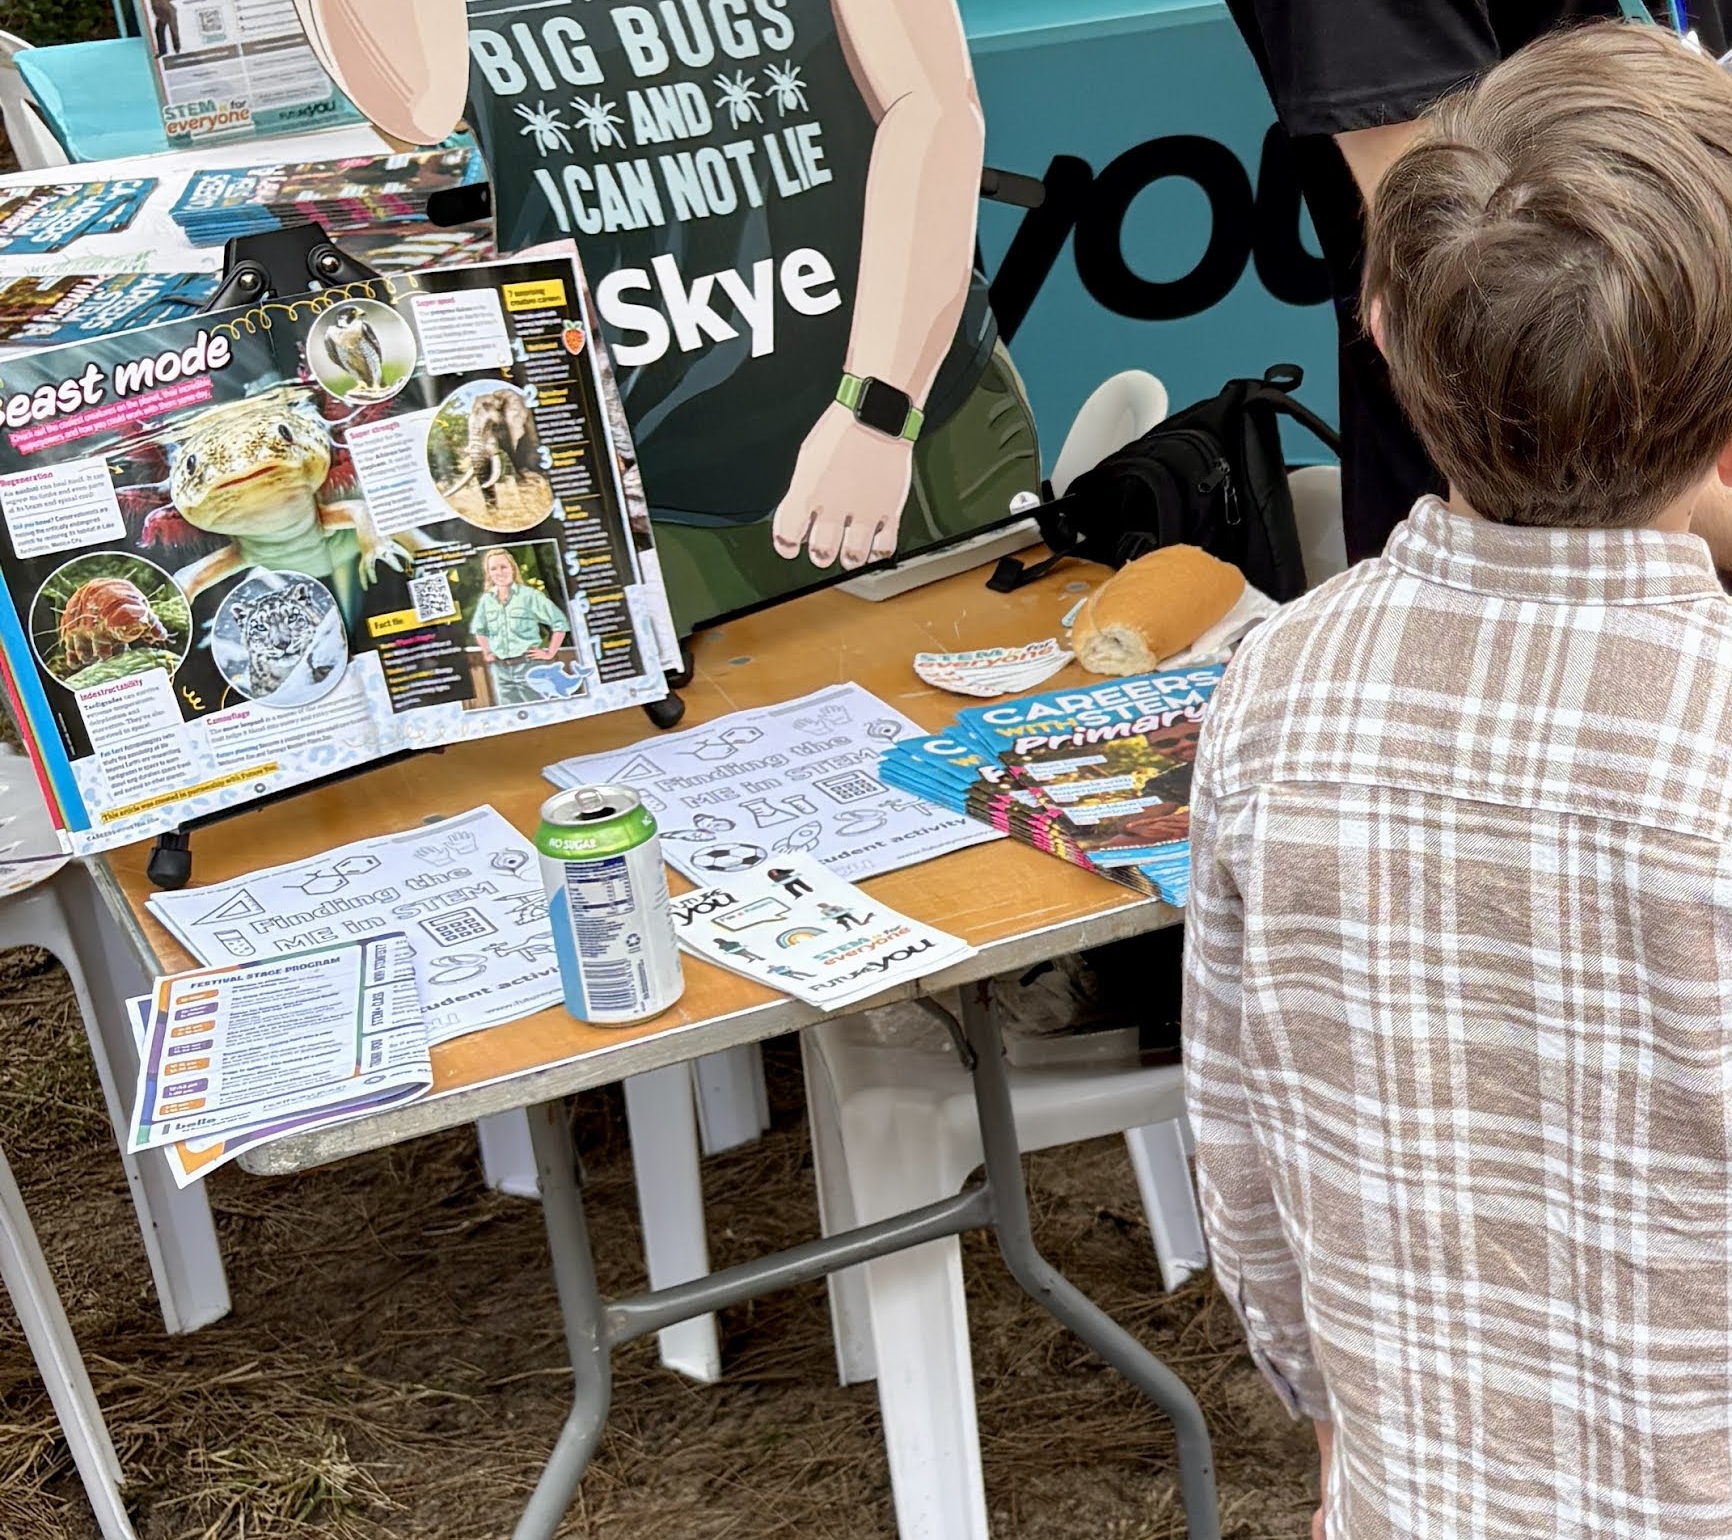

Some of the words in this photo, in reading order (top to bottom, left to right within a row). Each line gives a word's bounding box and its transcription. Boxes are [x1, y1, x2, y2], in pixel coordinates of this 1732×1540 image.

[469, 16, 604, 96] BIG
[164, 101, 215, 120] STEM
[230, 100, 246, 110] for
[167, 108, 250, 133] everyone
[626, 82, 713, 145] AND
[534, 168, 570, 233] I
[564, 158, 665, 234] CAN
[659, 140, 763, 222] NOT
[763, 121, 832, 199] LIE
[597, 247, 842, 367] Skye
[0, 363, 105, 427] east
[115, 331, 231, 395] mode
[524, 384, 540, 408] 2
[537, 445, 553, 470] 3
[564, 550, 580, 576] 5
[374, 619, 391, 630] Fact
[1027, 640, 1053, 651] for
[918, 646, 1053, 668] everyone
[982, 670, 1224, 725] CAREERS
[995, 717, 1078, 737] WITH
[1076, 690, 1206, 726] STEM
[1014, 701, 1209, 755] Primary
[654, 753, 789, 793] Finding
[792, 735, 852, 757] the
[680, 787, 742, 810] ME
[744, 776, 782, 794] in
[784, 748, 880, 781] STEM
[549, 837, 562, 849] NO
[563, 838, 598, 850] SUGAR
[820, 839, 884, 866] tudent
[890, 817, 967, 843] activity
[250, 885, 402, 935] Finding
[405, 866, 472, 891] the
[272, 927, 340, 953] ME
[341, 914, 387, 934] in
[392, 880, 499, 919] STEM
[670, 888, 724, 908] UTURE
[812, 937, 872, 961] STEM
[884, 925, 902, 935] for
[823, 927, 911, 965] everyone
[190, 974, 243, 988] FESTIVAL
[246, 968, 283, 980] STAGE
[285, 956, 341, 974] PROGRAM
[420, 987, 491, 1013] tudent
[498, 964, 562, 991] activi
[808, 962, 878, 991] FUTURE
